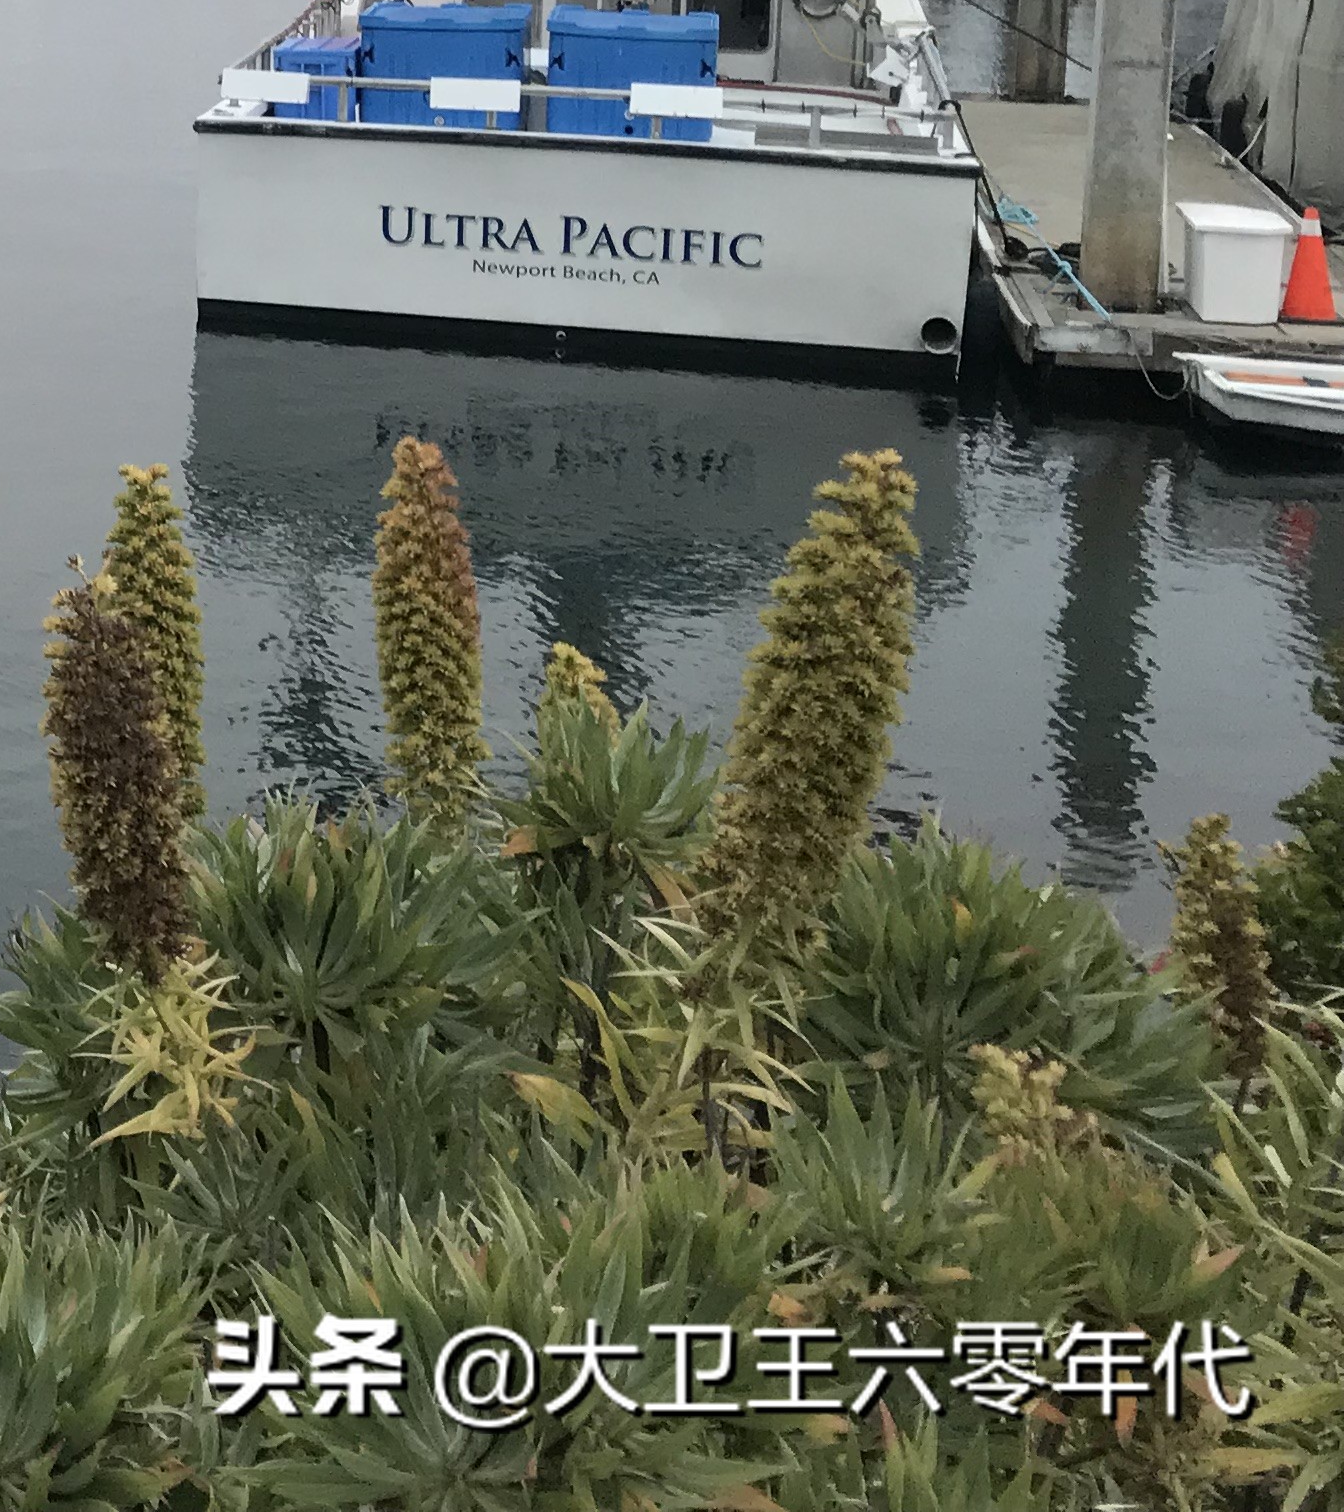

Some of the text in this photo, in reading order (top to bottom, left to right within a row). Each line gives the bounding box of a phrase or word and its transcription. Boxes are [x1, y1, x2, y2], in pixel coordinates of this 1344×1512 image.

[378, 204, 764, 270] ULTRA PACIFIC
[472, 259, 661, 286] Newport Beach, CA
